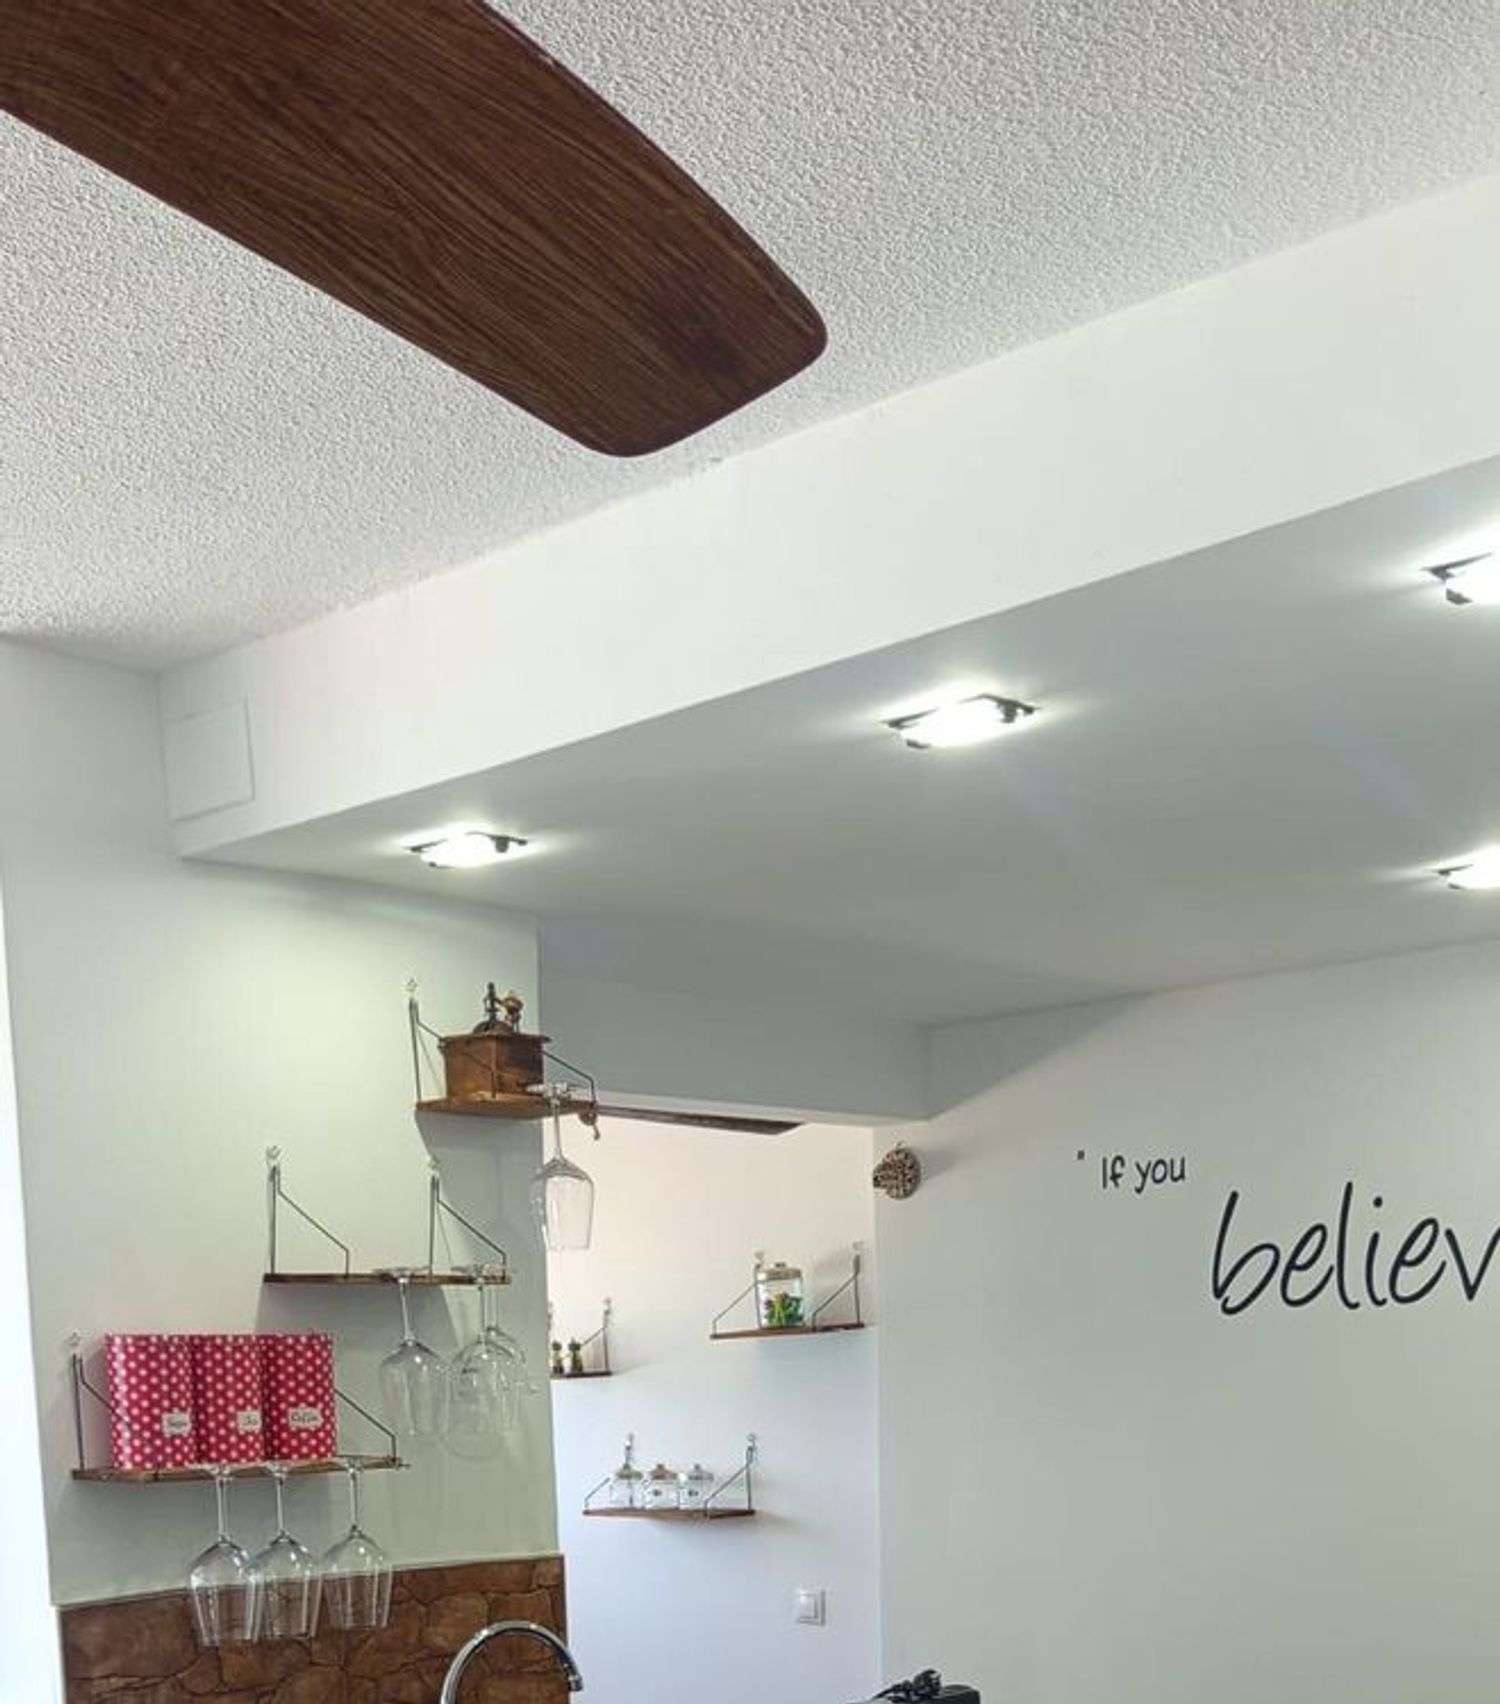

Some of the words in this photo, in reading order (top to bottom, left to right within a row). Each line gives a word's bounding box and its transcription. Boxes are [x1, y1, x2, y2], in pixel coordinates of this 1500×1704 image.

[1102, 1154, 1126, 1189] If
[1134, 1155, 1186, 1195] you
[1211, 1181, 1500, 1315] believ
